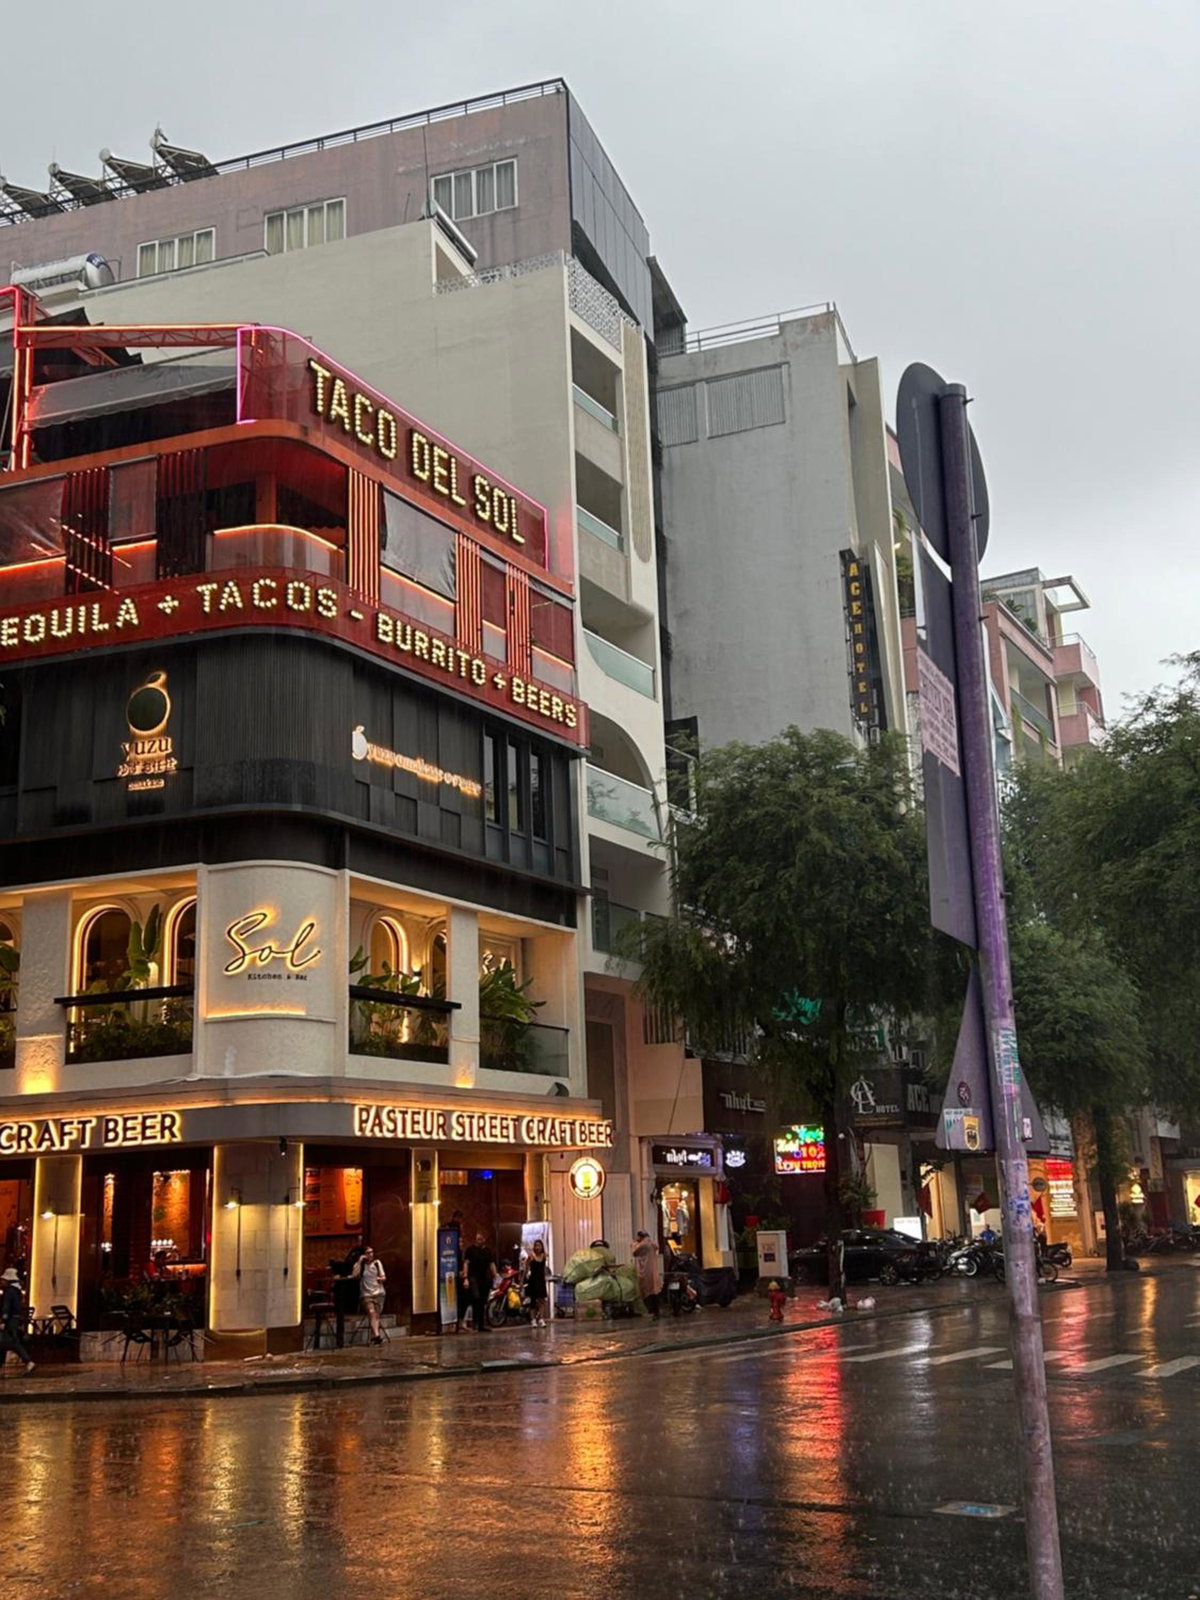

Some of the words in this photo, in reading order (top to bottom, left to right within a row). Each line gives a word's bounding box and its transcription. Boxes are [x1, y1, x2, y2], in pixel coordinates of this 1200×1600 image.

[309, 360, 397, 459] TACO
[413, 432, 466, 506] DEL
[475, 474, 525, 544] SOL
[196, 578, 337, 618] TACOS
[377, 611, 486, 686] BURRITO
[511, 676, 577, 728] BEERS
[849, 562, 861, 616] ACE
[855, 623, 868, 714] HOTEL
[223, 910, 322, 974] Sol
[0, 1115, 97, 1156] CRAFT
[102, 1110, 182, 1147] BEER
[354, 1103, 447, 1139] PASTEUR
[450, 1111, 518, 1144] STREET
[522, 1117, 576, 1146] CRAFT
[576, 1120, 613, 1148] BEER
